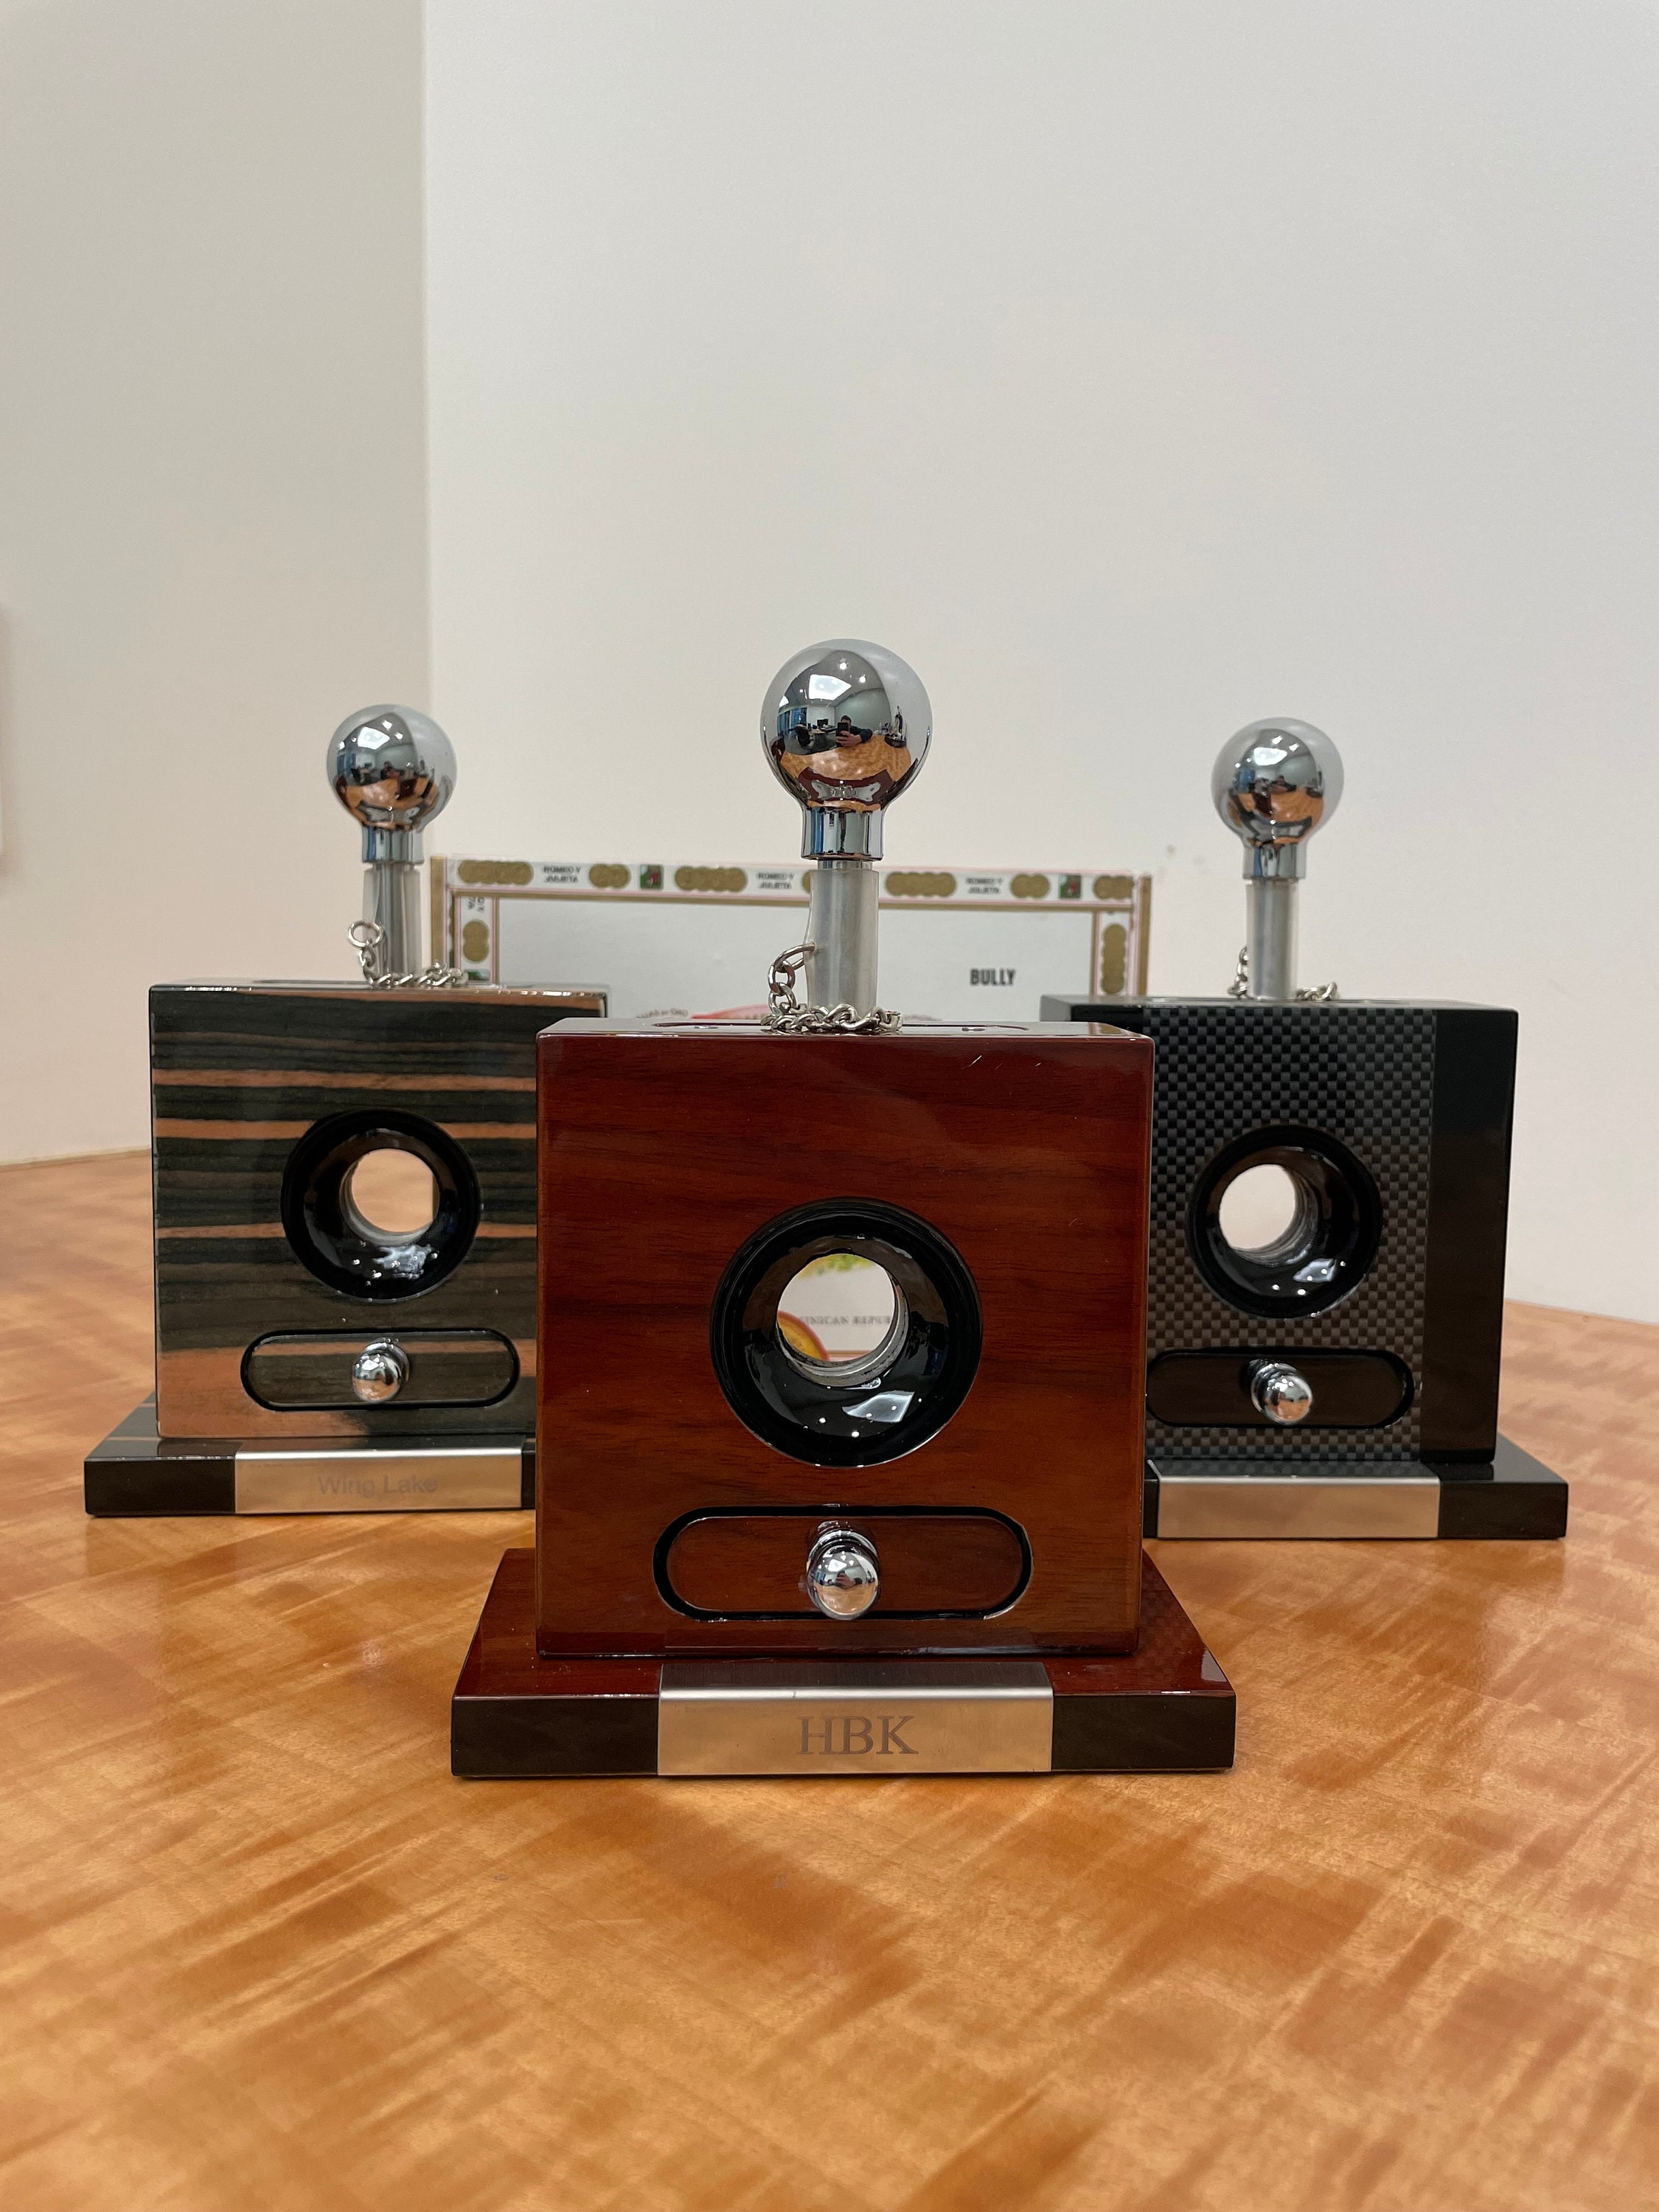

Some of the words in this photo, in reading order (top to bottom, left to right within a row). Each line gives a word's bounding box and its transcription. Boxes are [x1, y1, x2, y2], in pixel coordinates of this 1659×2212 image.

[970, 967, 1015, 986] BULLY
[317, 1475, 376, 1499] Wing
[383, 1475, 437, 1493] Lake
[796, 1715, 919, 1756] HBK
